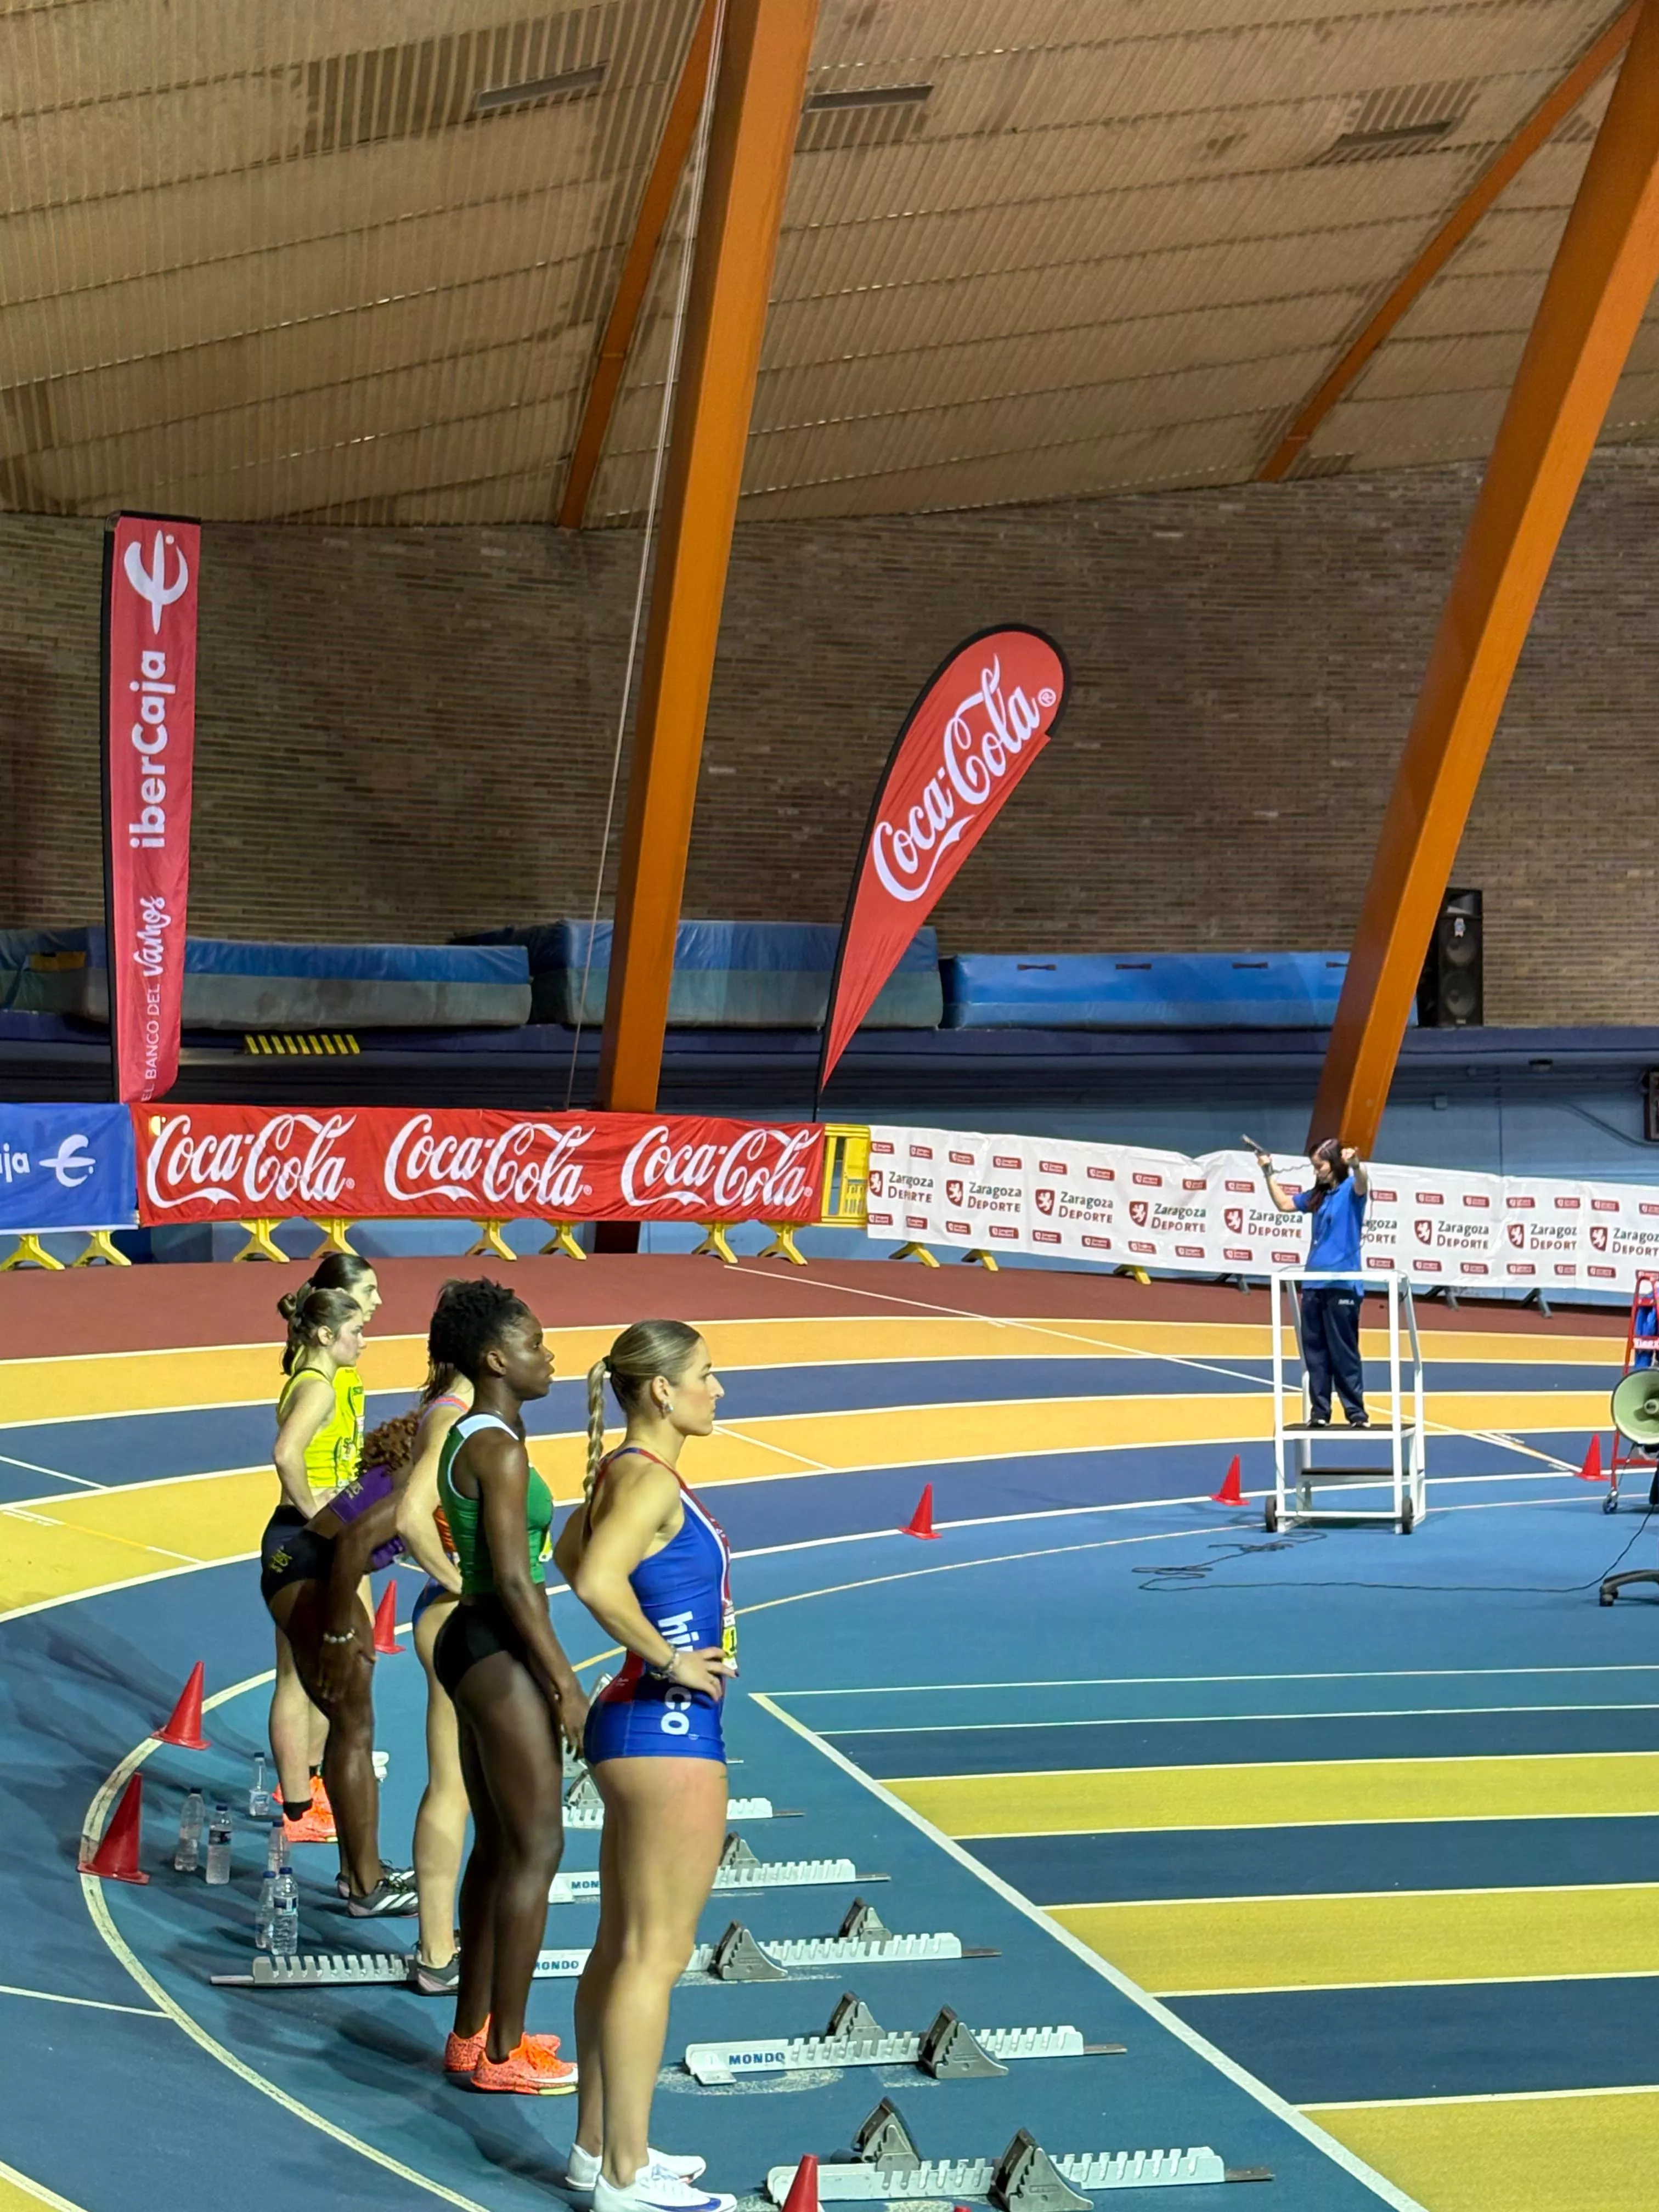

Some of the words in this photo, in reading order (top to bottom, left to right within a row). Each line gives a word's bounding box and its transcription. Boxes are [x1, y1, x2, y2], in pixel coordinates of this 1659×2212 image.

[129, 650, 176, 848] iberCaja
[873, 653, 1040, 902] Coca-Cola
[146, 984, 160, 1016] DEL
[145, 1022, 160, 1080] BANCO
[140, 1085, 155, 1102] EL
[147, 1114, 357, 1209] Coca-Cola
[384, 1113, 596, 1206] Coca-Cola
[620, 1125, 822, 1207] Coca-Cola
[969, 1181, 1022, 1199] Zaragoza
[967, 1195, 1021, 1212] DEPORTE
[1060, 1191, 1113, 1210] Zaragoza
[1058, 1205, 1113, 1223] DEPORTE
[1154, 1203, 1206, 1220] Zaragoza
[1249, 1209, 1303, 1226] Zaragoza
[1248, 1222, 1302, 1239] DEPORTE
[1438, 1220, 1489, 1237] Zaragoza
[1531, 1223, 1577, 1239] Zaragoz
[1613, 1227, 1659, 1245] Zaragoz
[1437, 1234, 1488, 1250] DEPORTE
[1530, 1237, 1577, 1251] DEPORT
[1612, 1240, 1659, 1257] DEPORT
[571, 1881, 600, 1889] MON
[729, 2052, 786, 2066] MONDO
